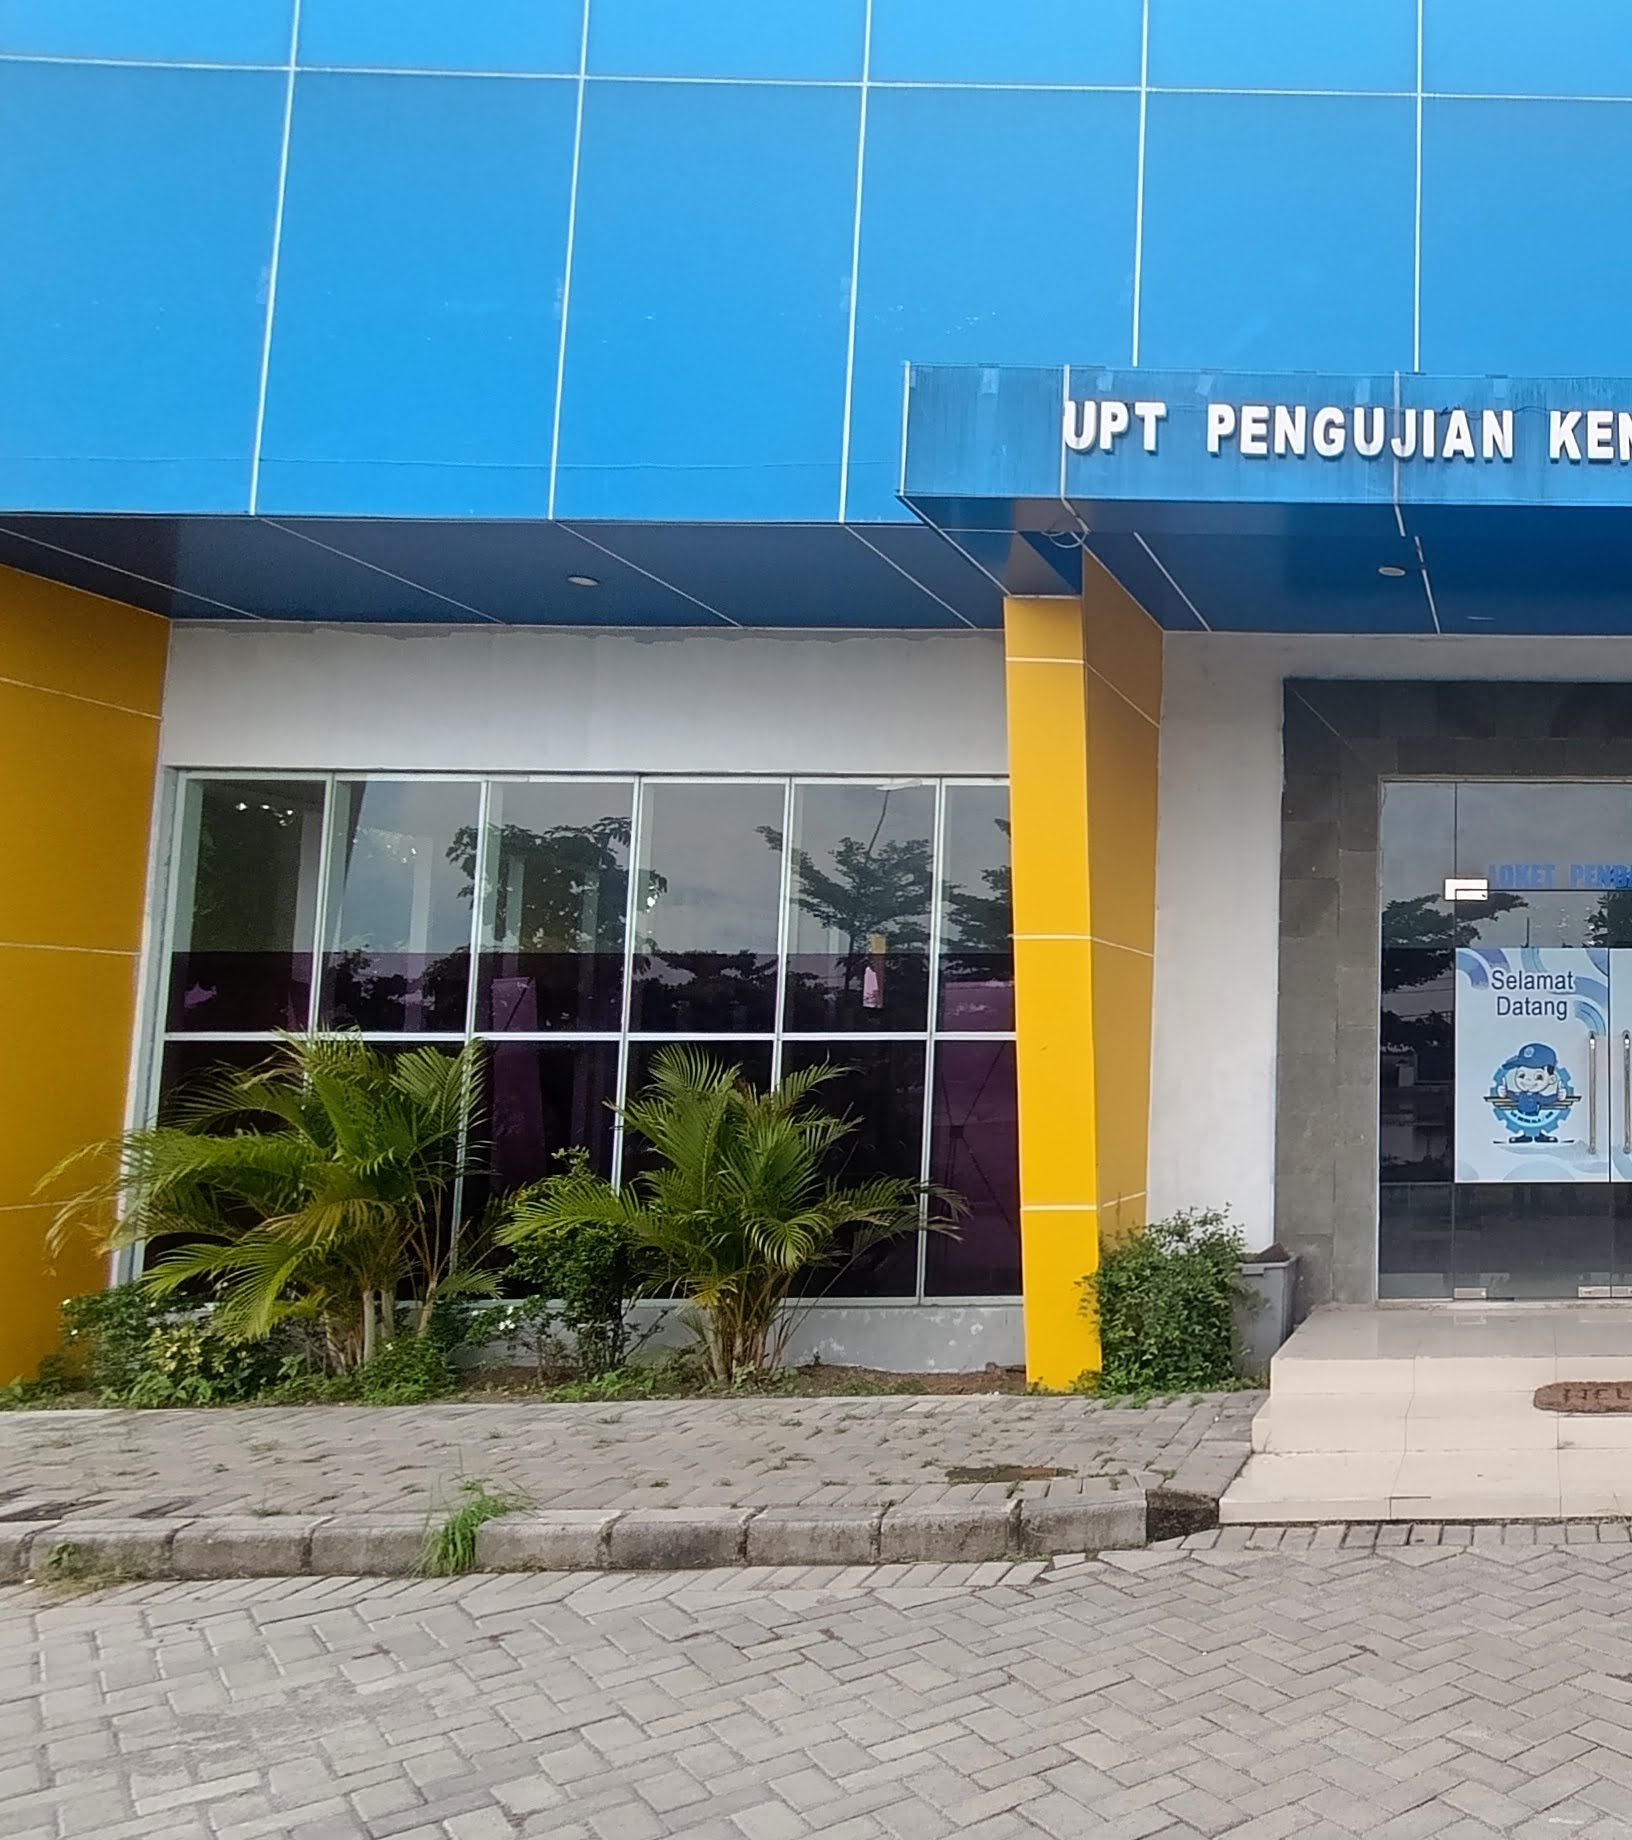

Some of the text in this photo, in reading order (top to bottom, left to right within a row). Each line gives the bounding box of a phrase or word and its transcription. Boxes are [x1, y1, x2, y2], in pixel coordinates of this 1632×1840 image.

[1063, 400, 1166, 452] UPT
[1207, 404, 1515, 461] PENGUJIAN
[1491, 969, 1574, 990] Selamat
[1496, 996, 1568, 1021] Datang
